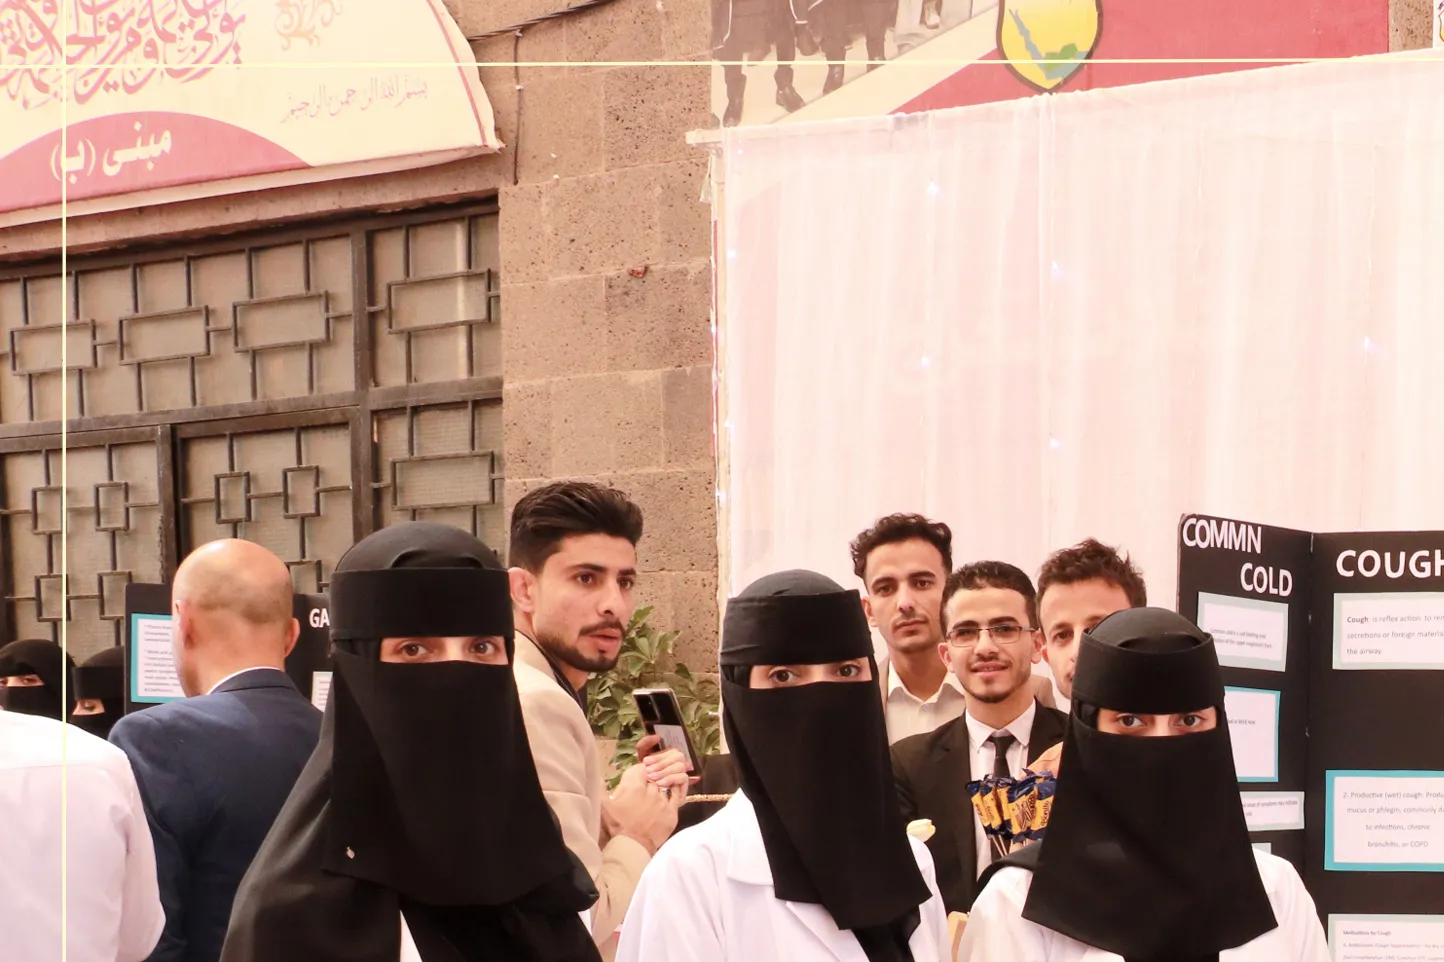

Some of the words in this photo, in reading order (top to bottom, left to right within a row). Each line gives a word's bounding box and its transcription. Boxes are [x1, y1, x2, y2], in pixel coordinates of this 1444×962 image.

[1182, 518, 1262, 554] COMMN
[1240, 562, 1293, 597] COLD
[1347, 616, 1368, 624] Cough
